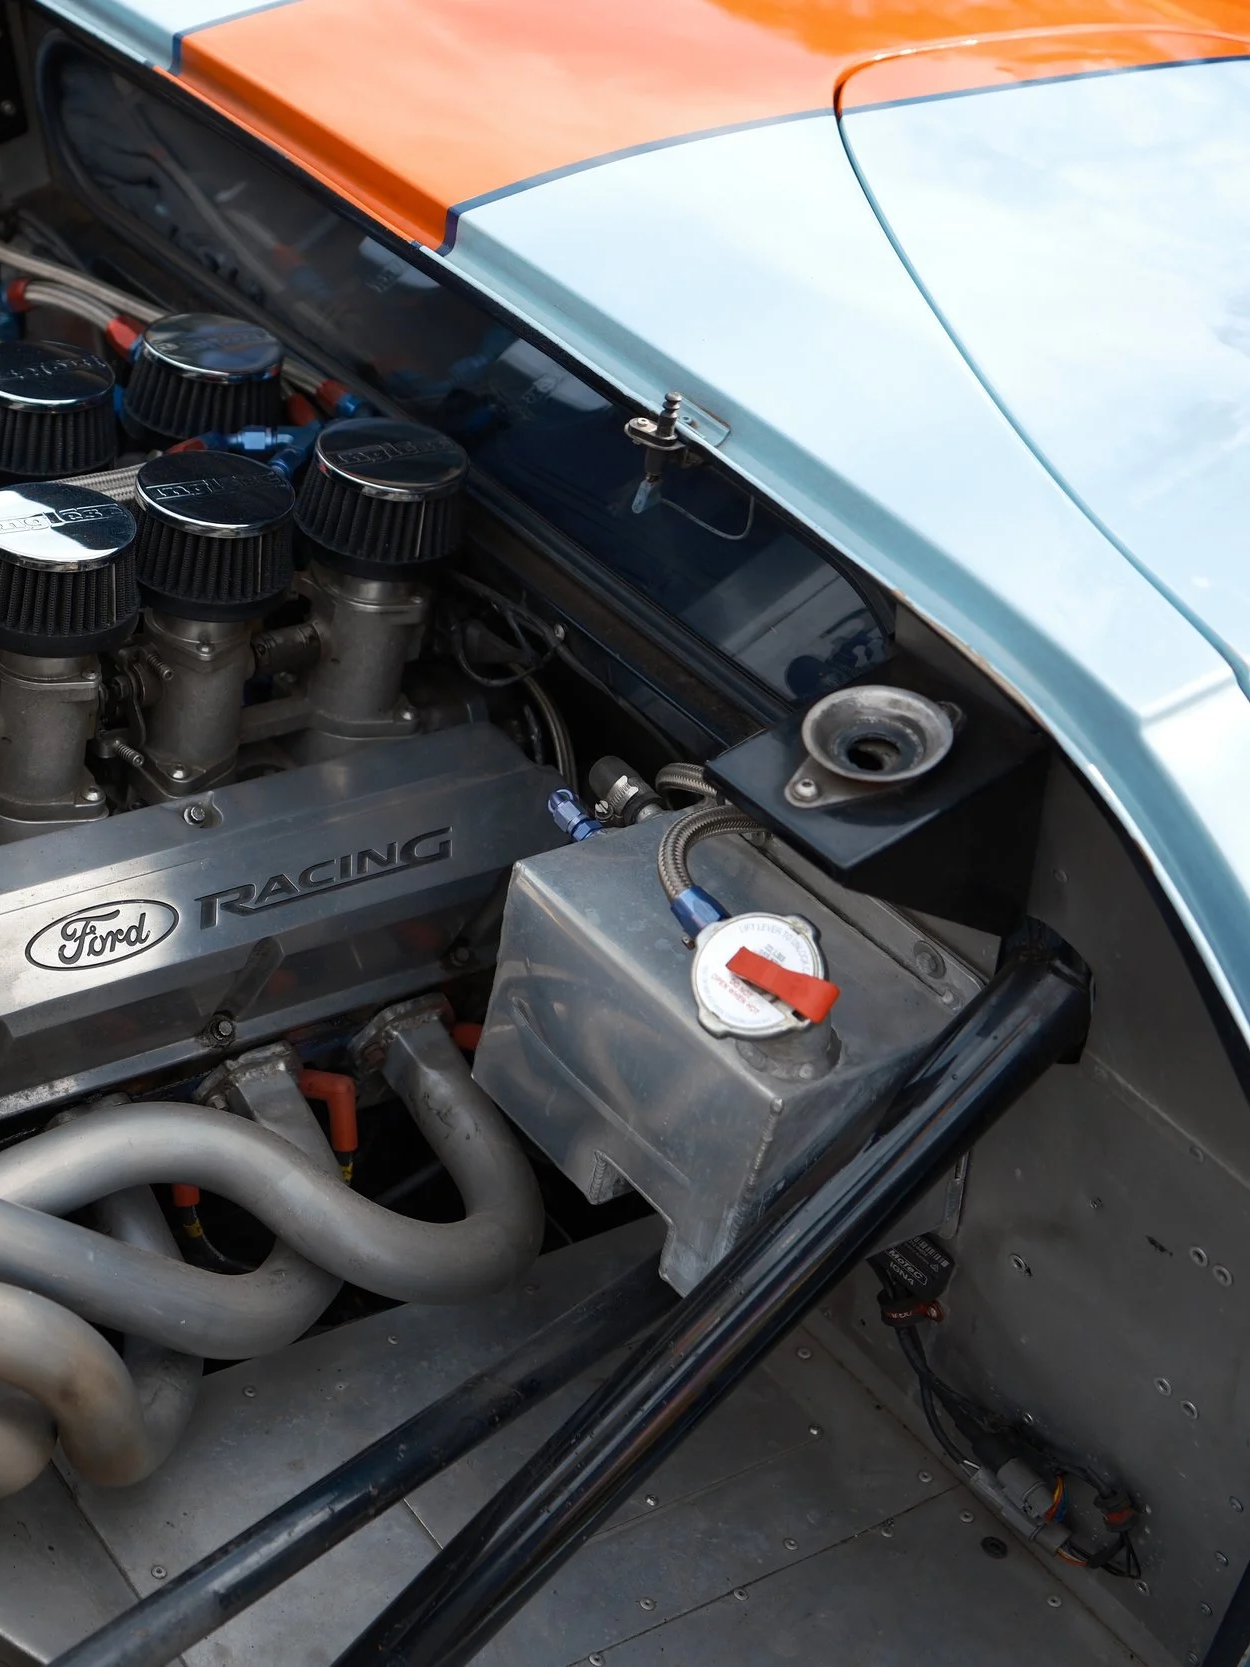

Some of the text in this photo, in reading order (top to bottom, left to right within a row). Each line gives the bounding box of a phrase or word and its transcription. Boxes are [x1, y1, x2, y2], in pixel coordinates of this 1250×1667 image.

[57, 826, 453, 966] Ford RACING
[710, 972, 729, 989] OPEN
